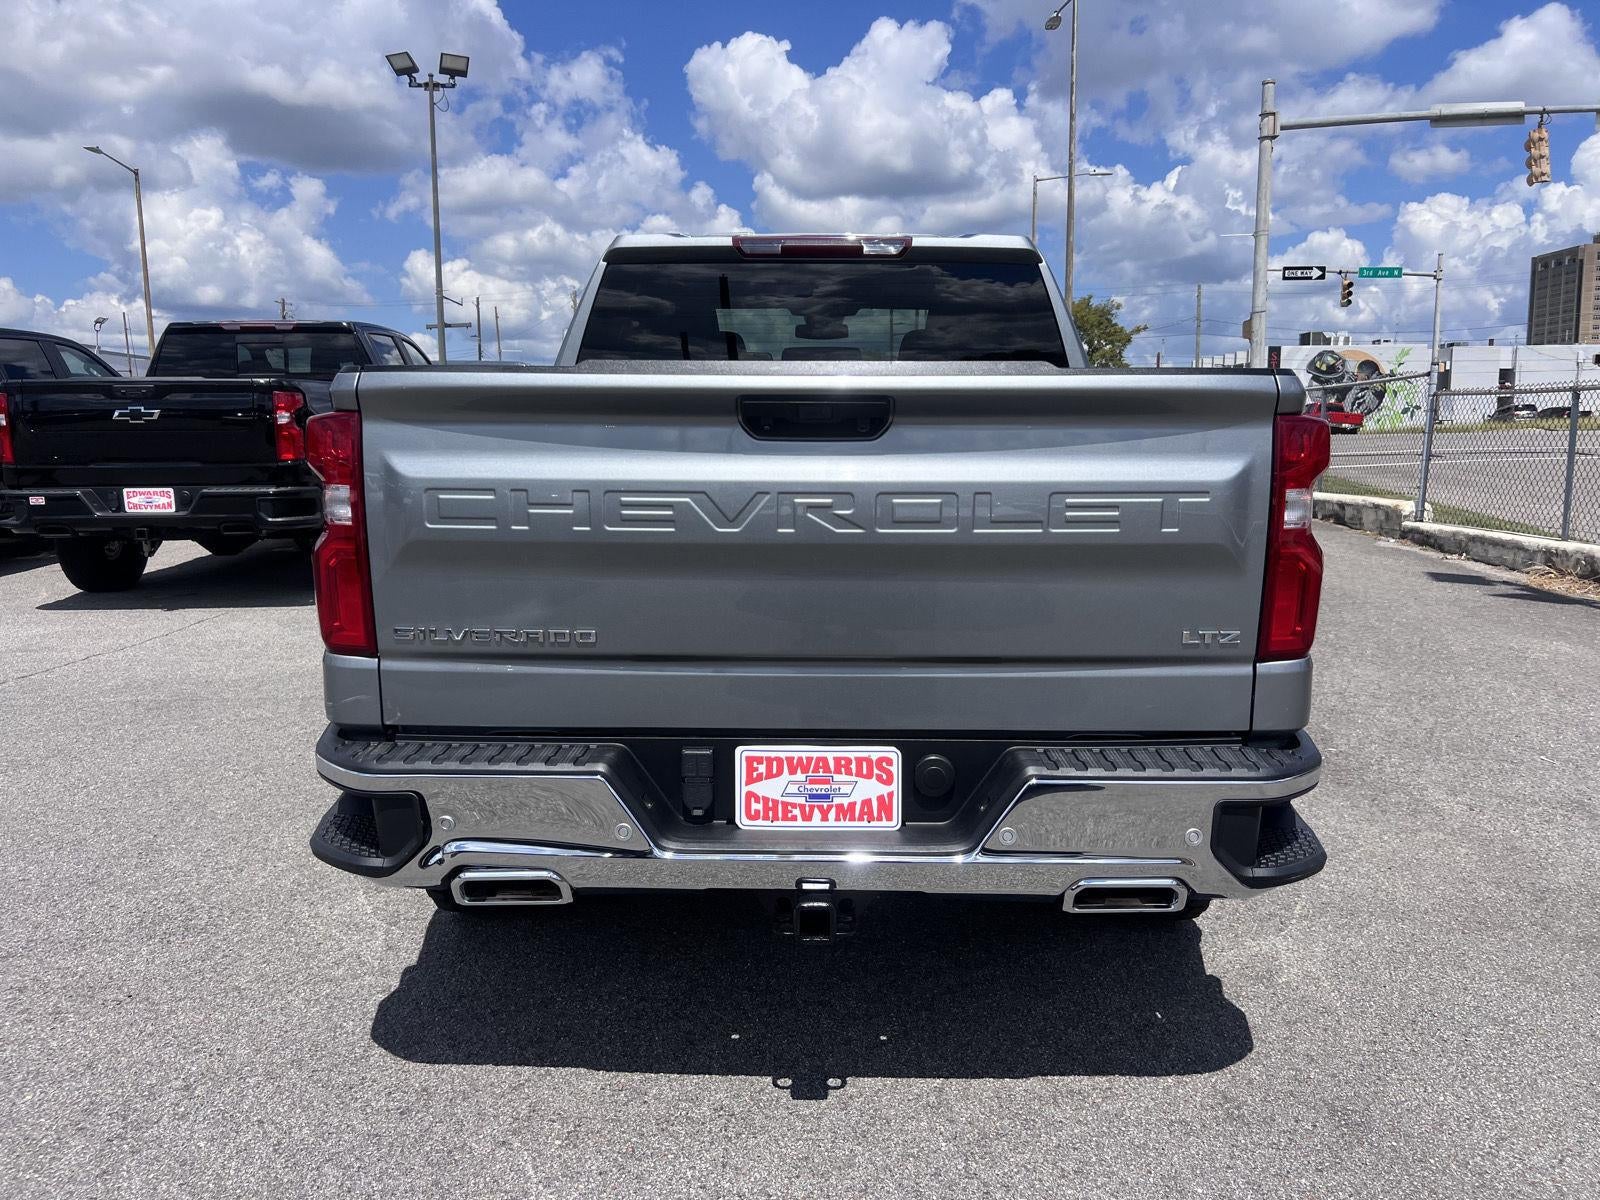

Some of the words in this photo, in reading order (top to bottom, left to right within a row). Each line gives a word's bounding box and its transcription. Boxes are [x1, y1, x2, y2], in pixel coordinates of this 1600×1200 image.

[1286, 269, 1299, 277] ONE
[1300, 269, 1313, 277] WAY
[1362, 268, 1373, 276] 3rd
[1378, 268, 1389, 276] Ave
[1394, 268, 1399, 276] N
[126, 490, 172, 499] EDWARDS
[127, 500, 172, 510] CHEVYMAN
[424, 488, 1211, 533] CHEVROLET
[393, 626, 598, 646] SILVERADO
[1181, 628, 1242, 646] LTZ
[745, 755, 894, 786] EDWARDS
[796, 784, 842, 794] Chevrolet
[745, 790, 894, 822] CHEVYMAN
